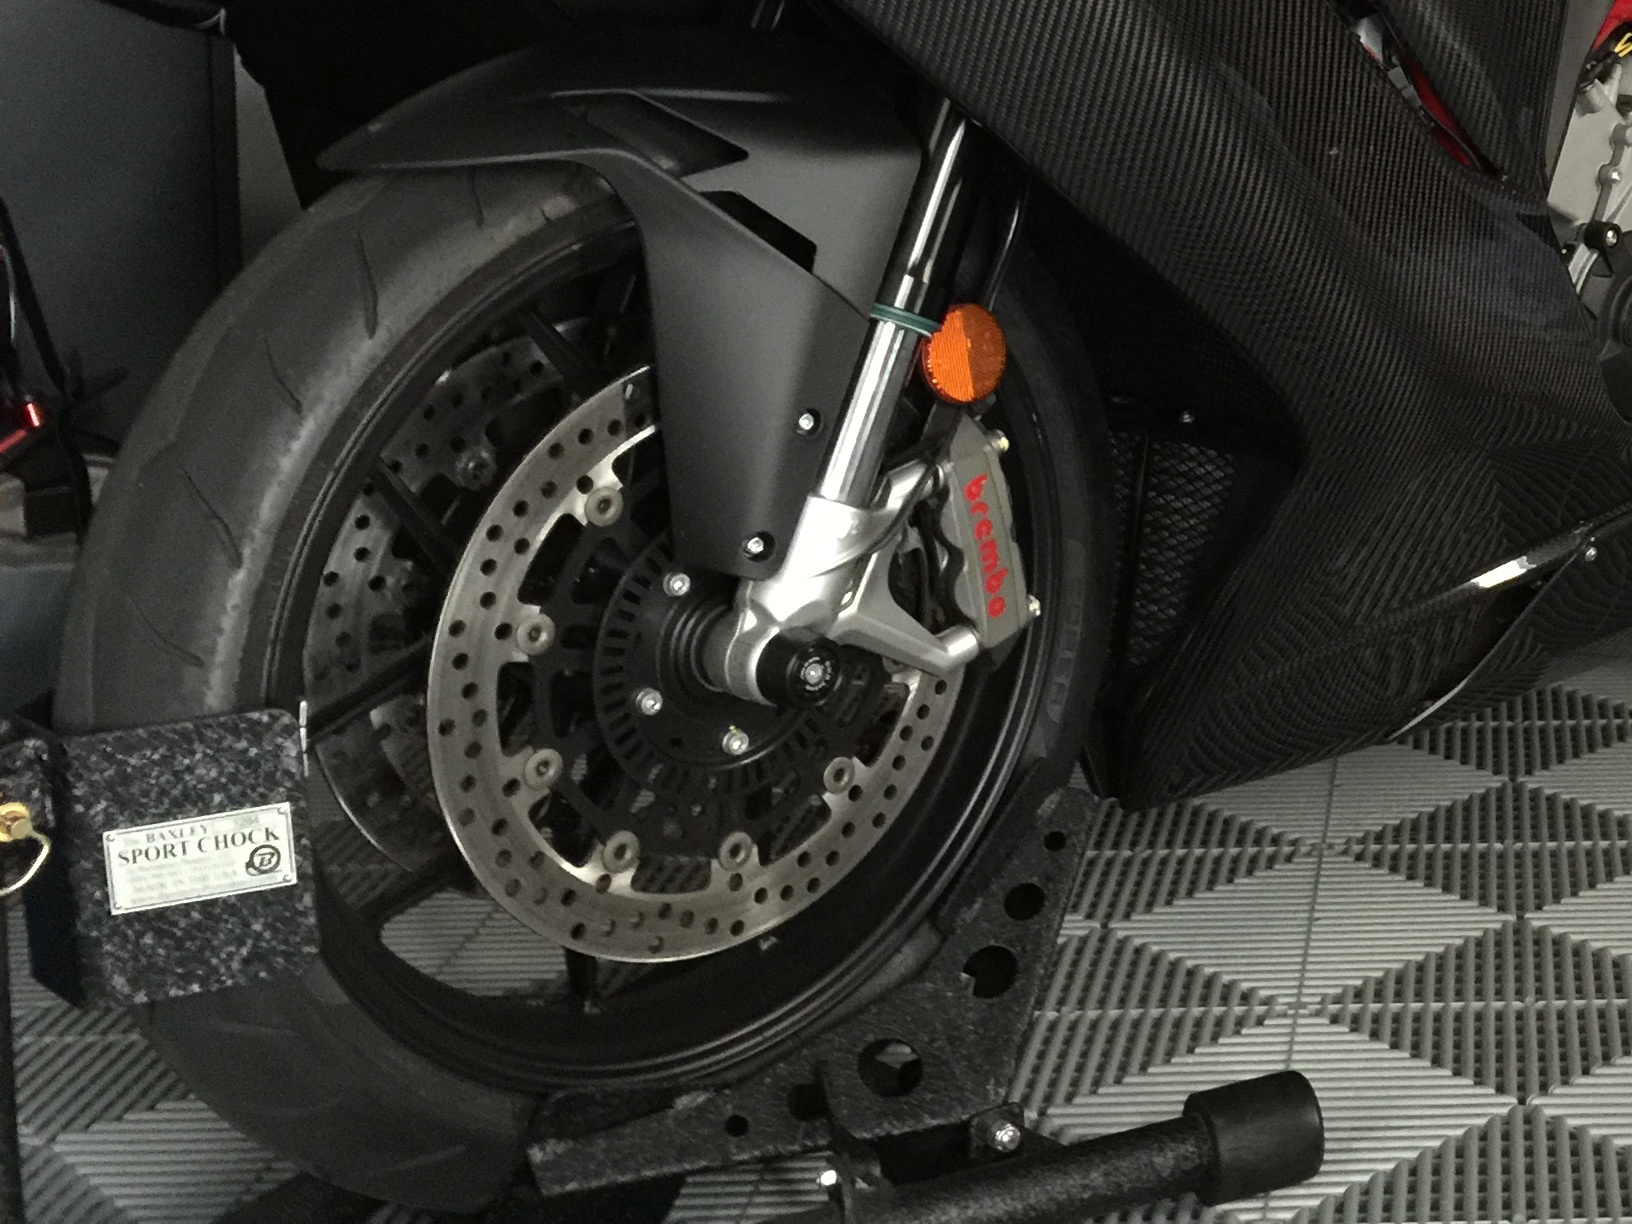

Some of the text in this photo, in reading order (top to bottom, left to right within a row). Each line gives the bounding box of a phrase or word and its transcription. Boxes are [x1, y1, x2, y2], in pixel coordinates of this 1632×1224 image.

[964, 473, 1010, 619] brembo
[117, 826, 280, 866] SPORT CHOCK
